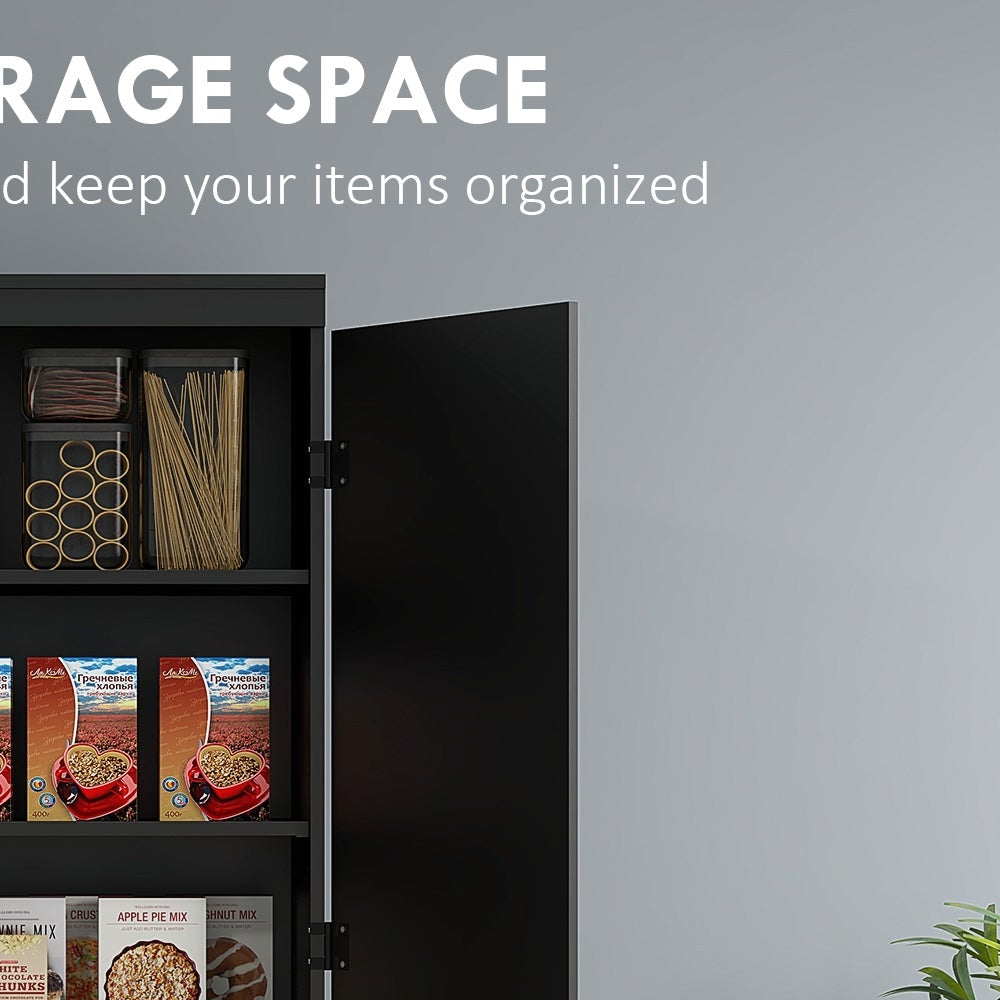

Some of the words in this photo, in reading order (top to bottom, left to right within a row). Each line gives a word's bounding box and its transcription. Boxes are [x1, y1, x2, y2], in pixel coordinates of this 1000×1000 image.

[77, 674, 133, 684] Гречневые
[210, 674, 266, 684] Гречневые
[70, 910, 98, 920] CRUS
[117, 912, 148, 922] APPLE
[151, 912, 166, 922] PIE
[169, 912, 188, 922] MIX
[239, 910, 257, 920] MIX
[34, 924, 56, 939] MIX
